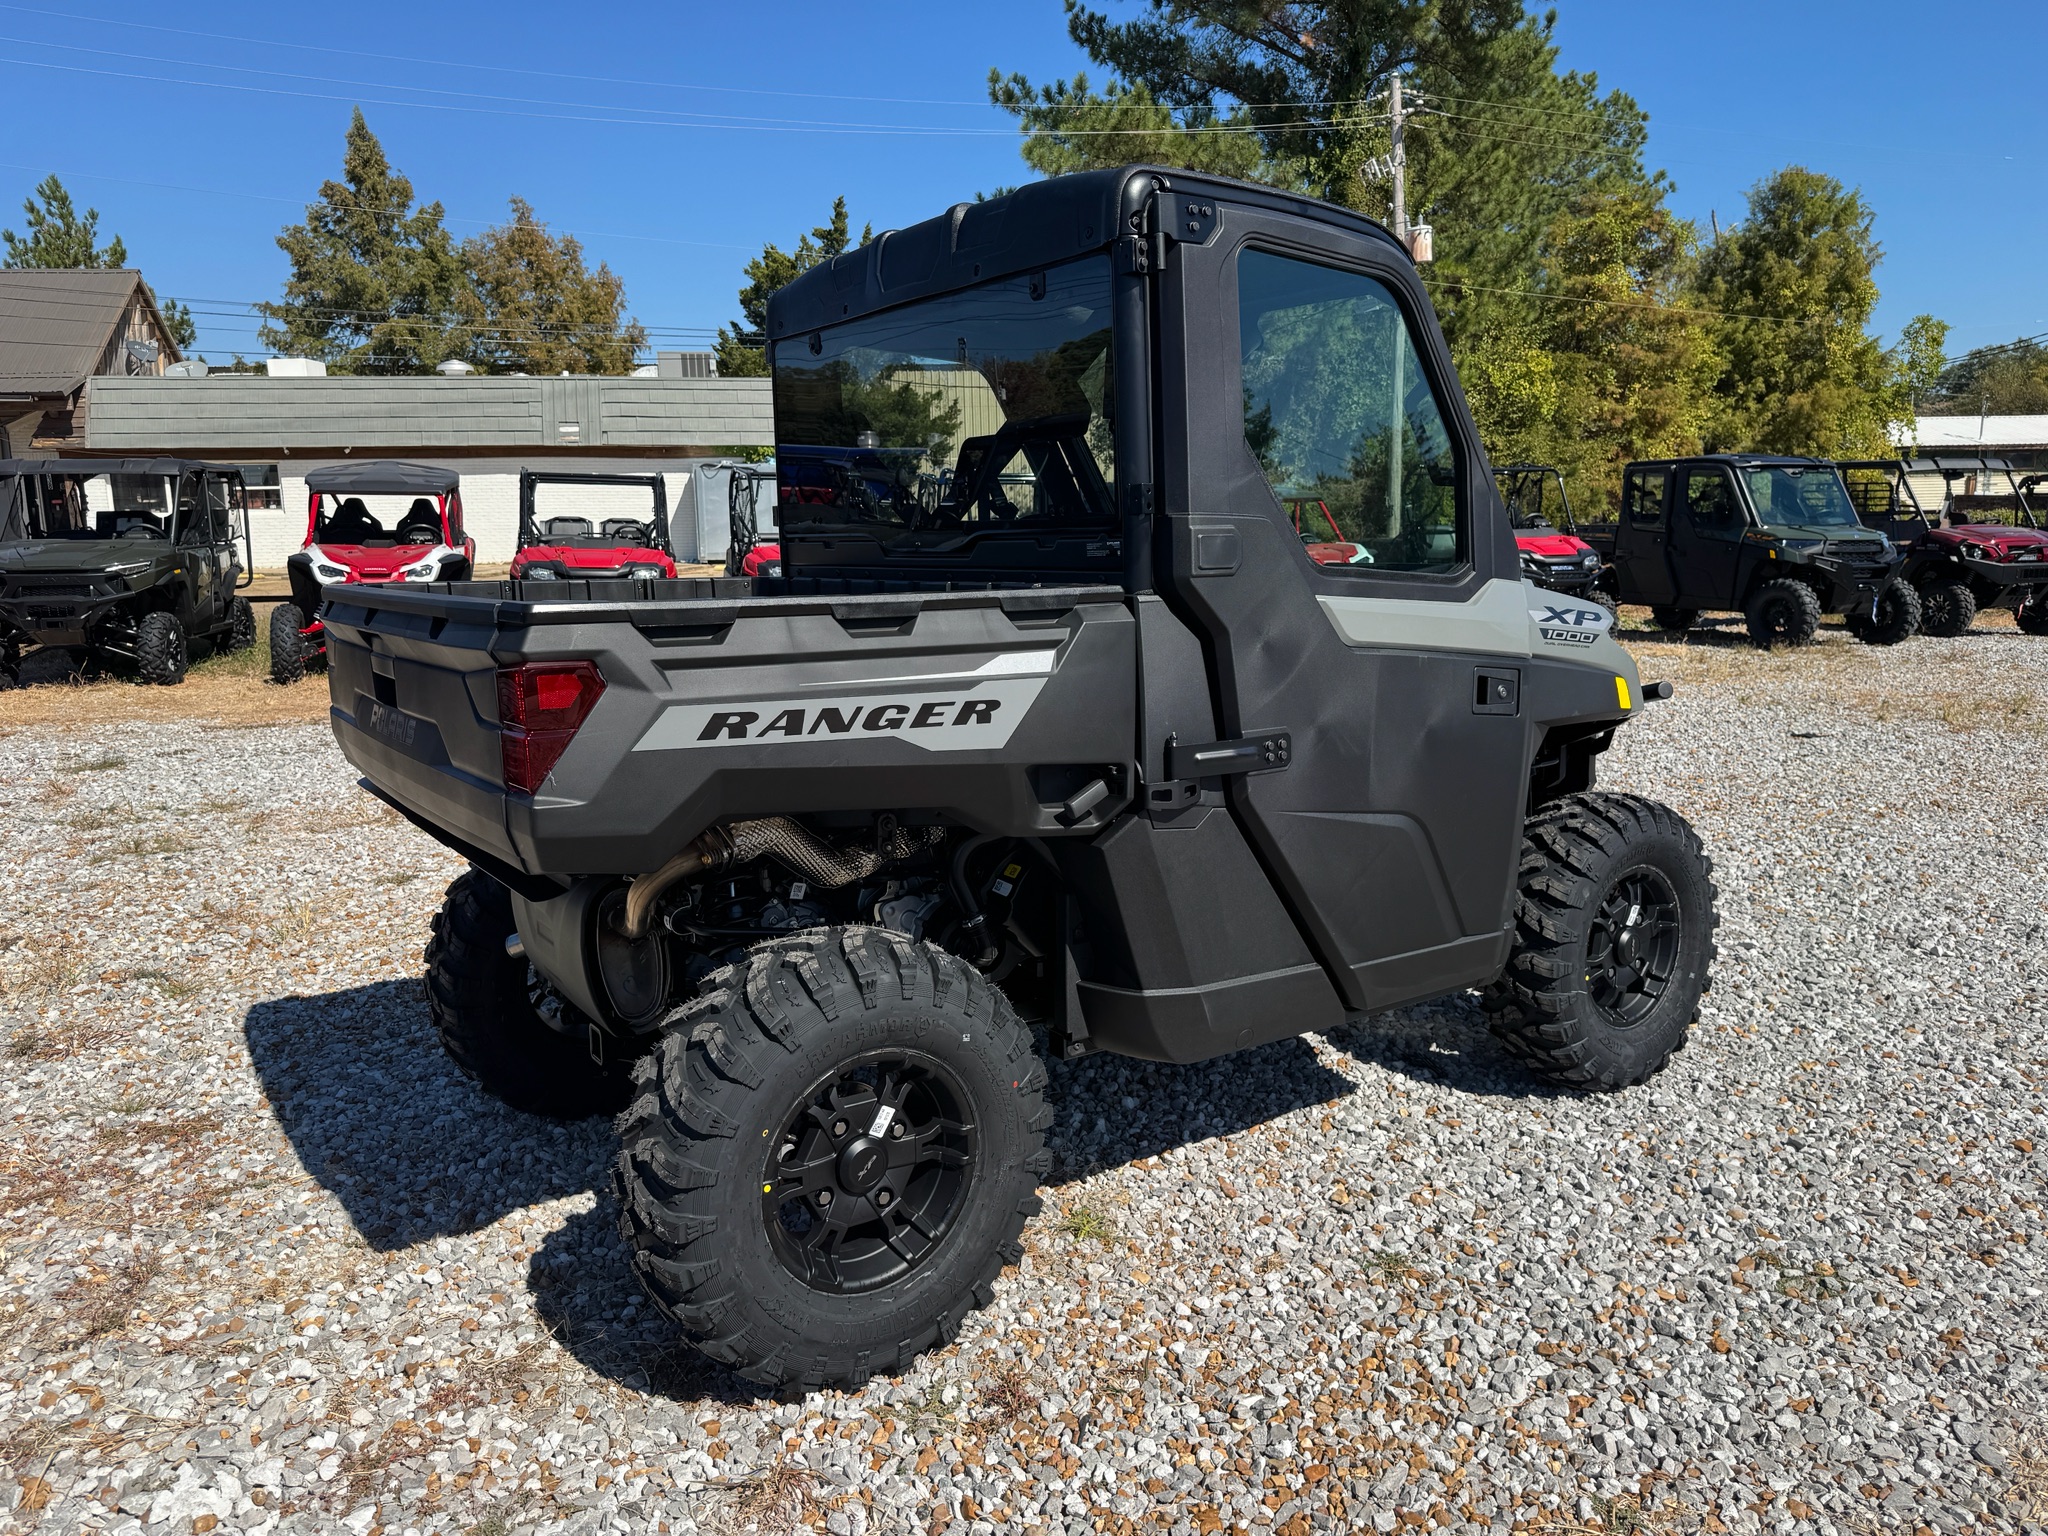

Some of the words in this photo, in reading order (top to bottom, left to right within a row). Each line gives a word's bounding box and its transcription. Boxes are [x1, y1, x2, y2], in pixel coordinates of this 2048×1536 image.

[1539, 606, 1602, 626] XP
[1547, 629, 1594, 643] 1000
[370, 703, 417, 746] POLARIS
[696, 700, 1001, 742] RANGER
